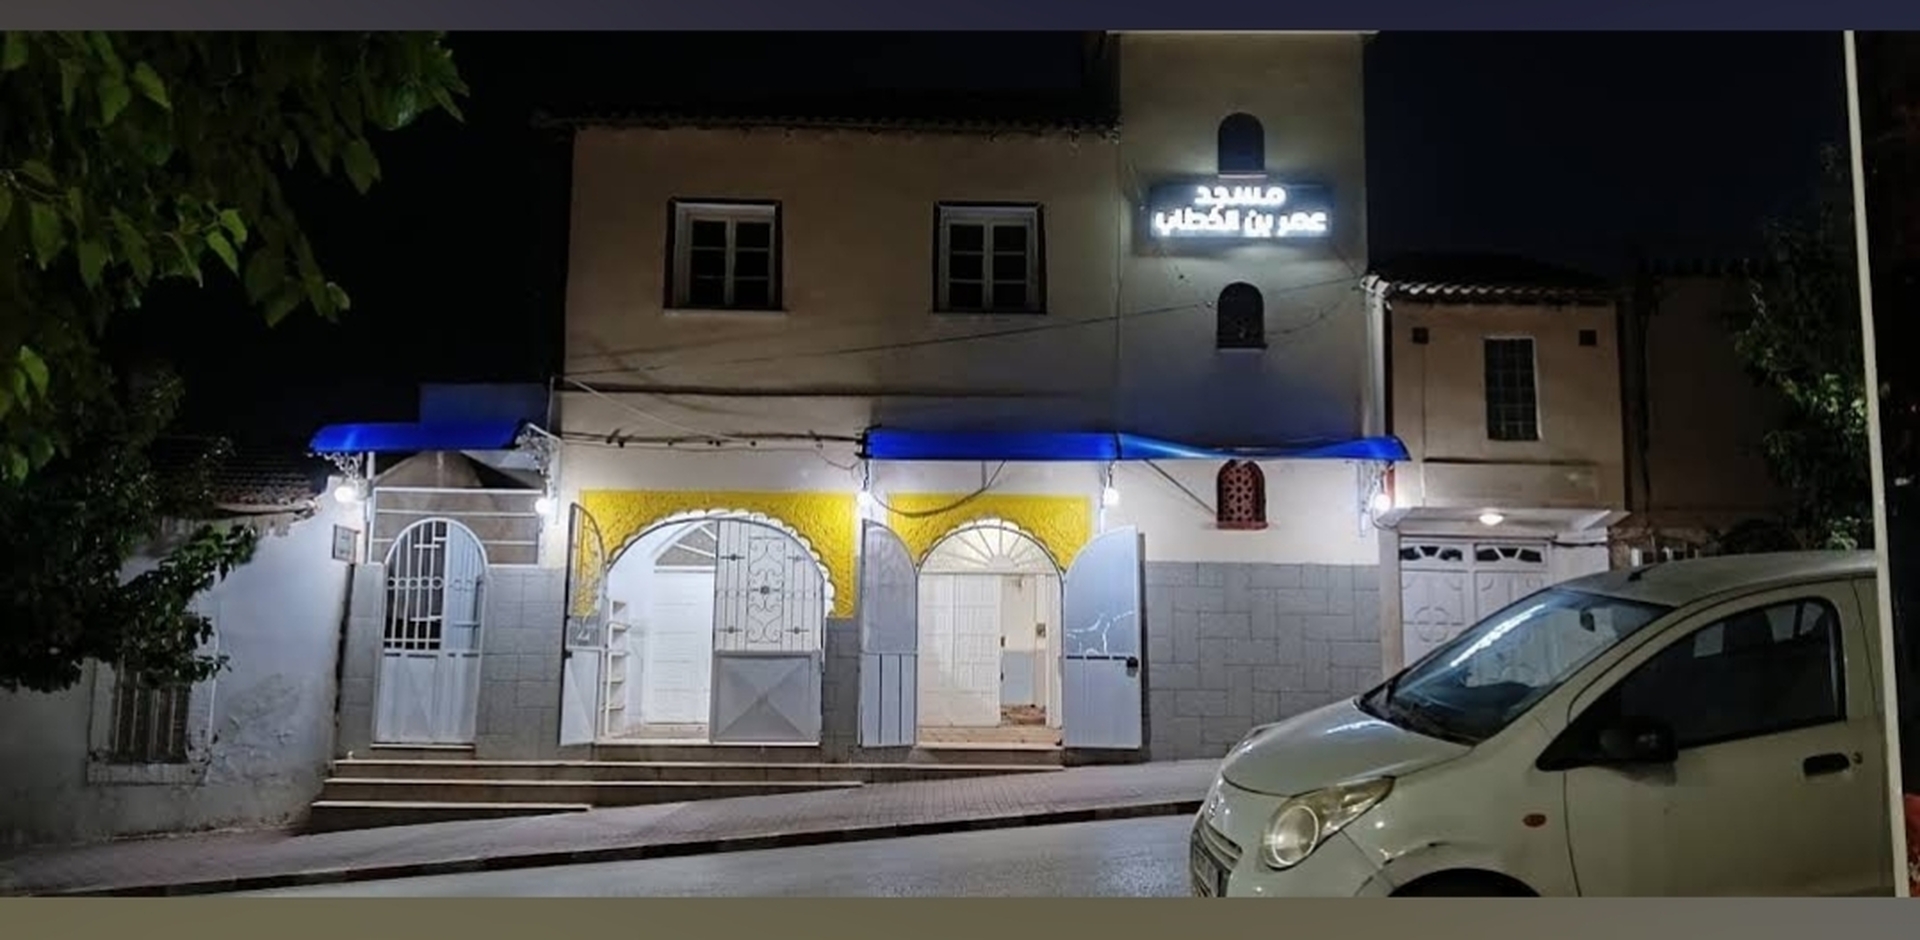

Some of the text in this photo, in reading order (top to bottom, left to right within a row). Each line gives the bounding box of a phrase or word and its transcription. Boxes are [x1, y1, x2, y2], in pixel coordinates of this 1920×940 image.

[1194, 185, 1287, 209] مسجد
[1155, 207, 1327, 237] عمر بن الخطاب
